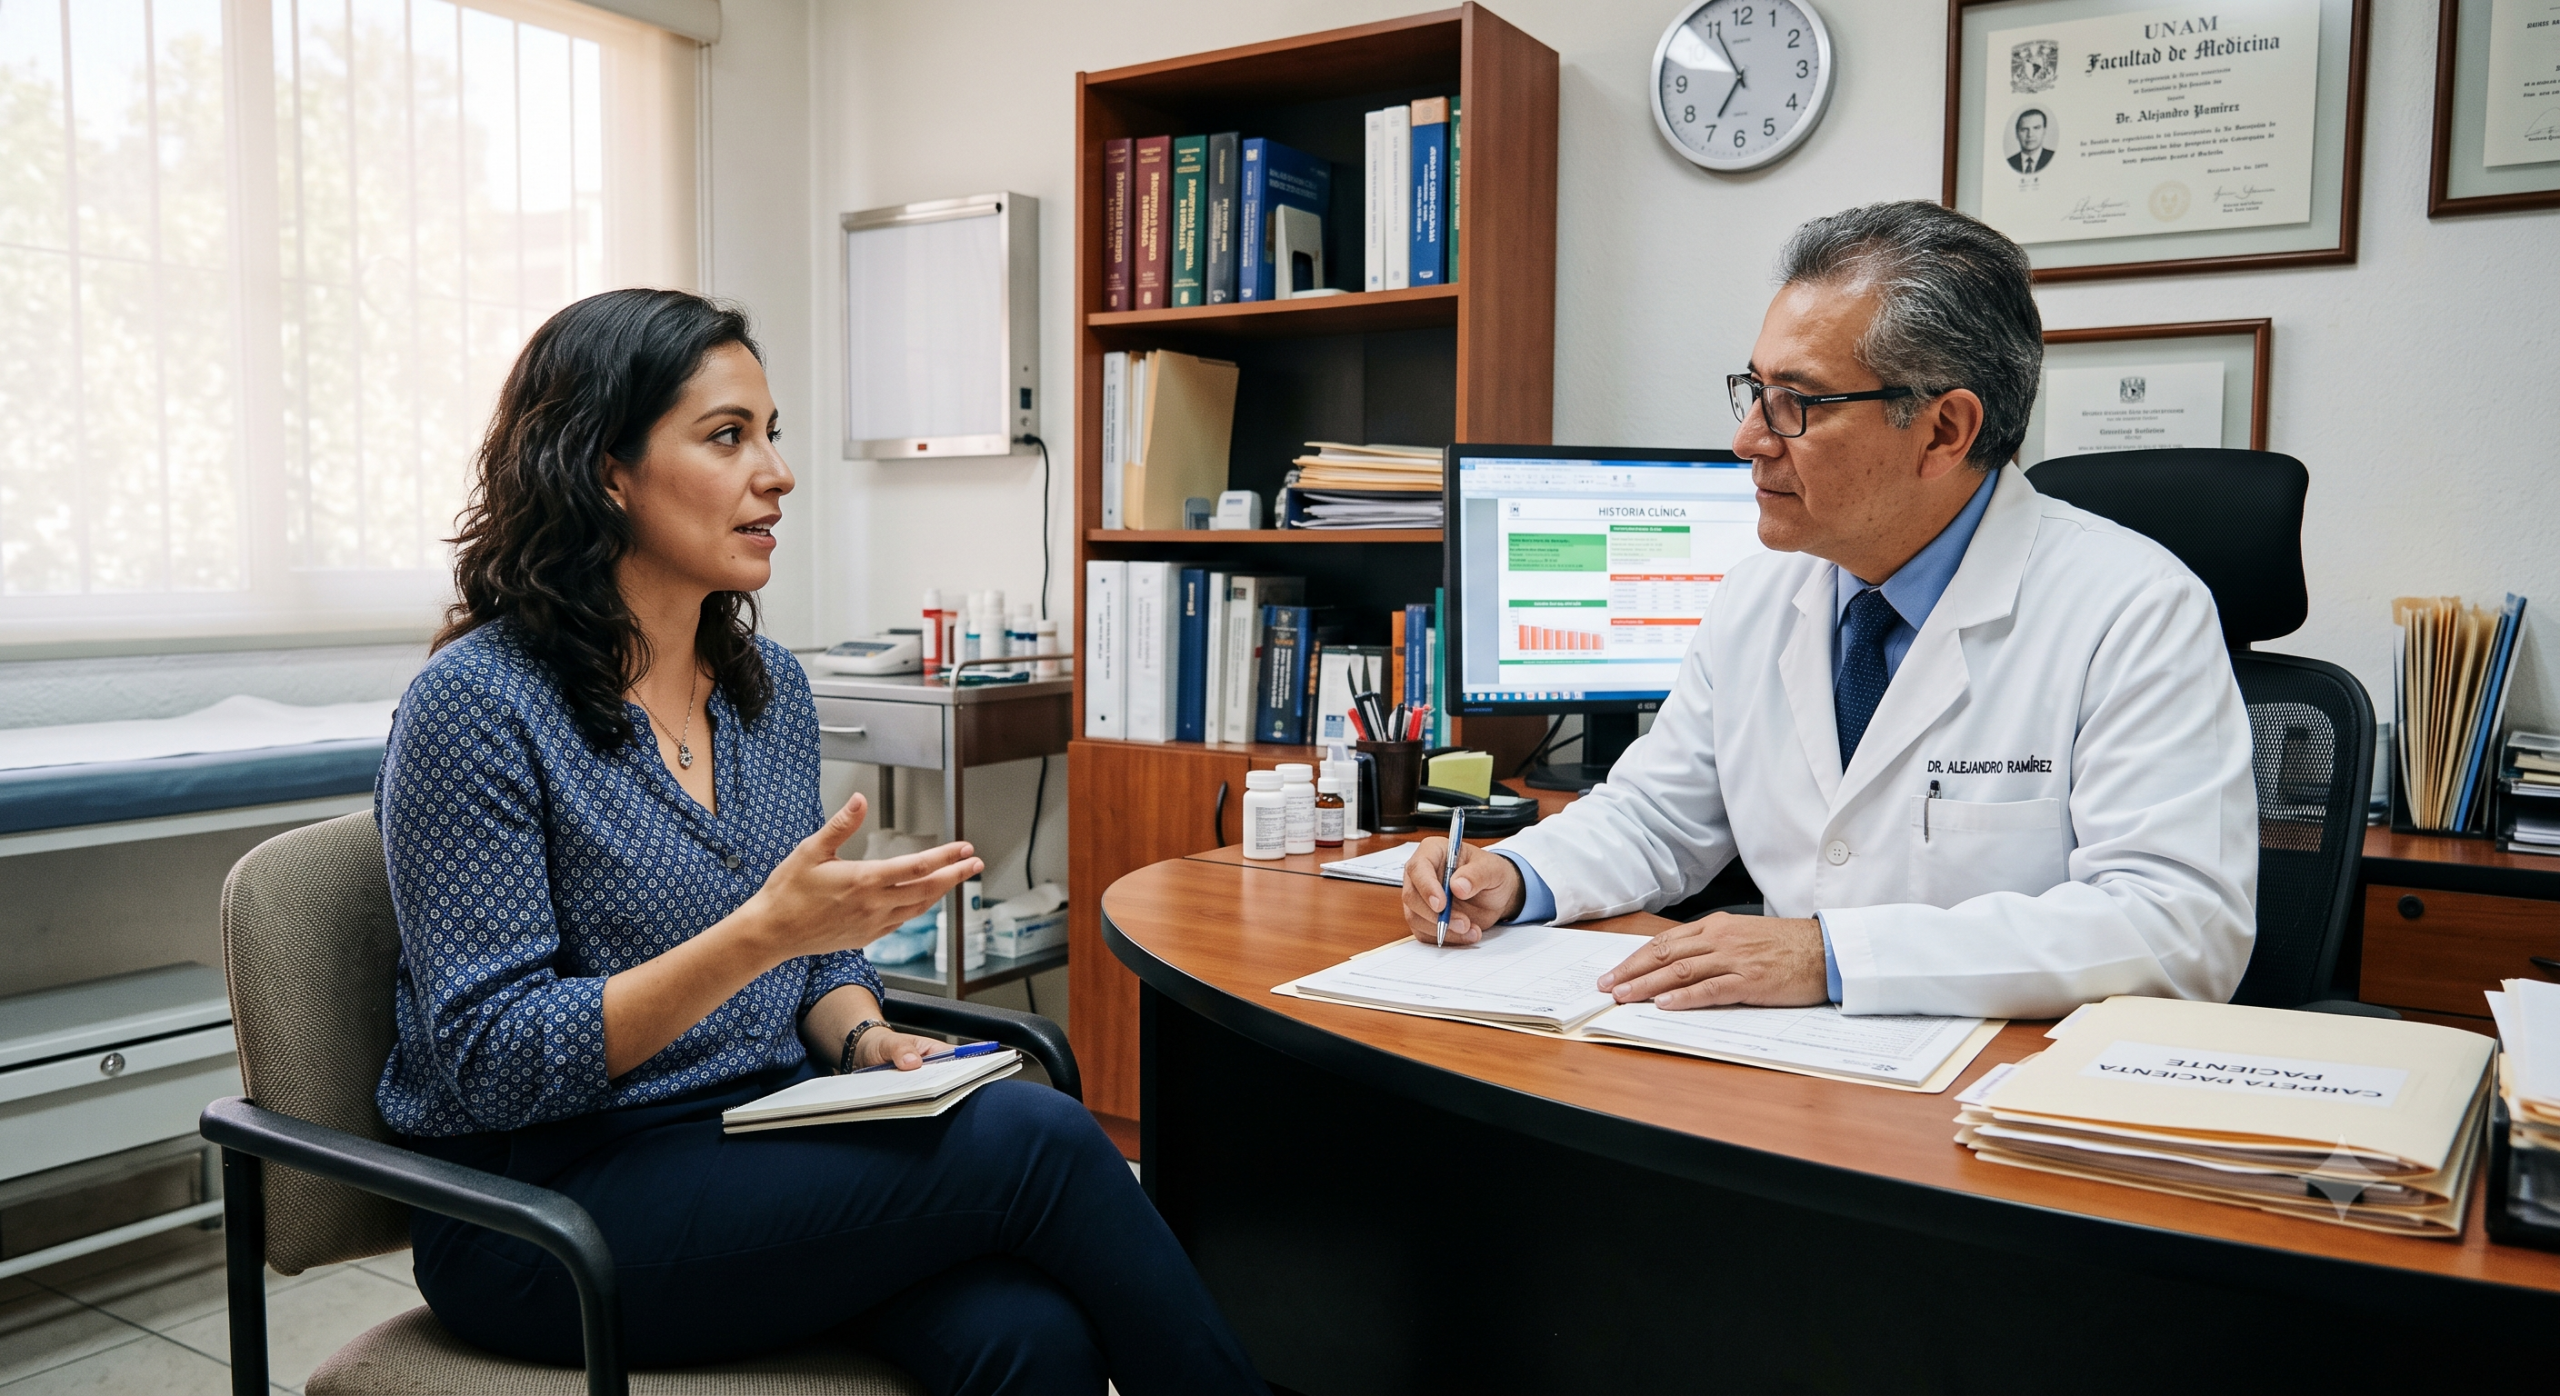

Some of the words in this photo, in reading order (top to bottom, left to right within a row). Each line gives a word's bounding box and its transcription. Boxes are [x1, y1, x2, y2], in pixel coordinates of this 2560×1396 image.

[1731, 6, 1754, 26] 12
[1768, 9, 1776, 27] 1
[1706, 20, 1722, 39] 11
[2144, 15, 2218, 40] UNAM
[1787, 29, 1800, 48] 2
[2085, 47, 2162, 75] Facultad
[2168, 45, 2187, 62] de
[2194, 34, 2280, 60] Medicina
[1796, 60, 1809, 78] 3
[1676, 76, 1687, 93] 9
[1786, 93, 1798, 111] 4
[1684, 105, 1695, 123] 8
[2137, 107, 2189, 123] Alejandro
[1705, 124, 1717, 142] 7
[1763, 118, 1775, 136] 5
[1734, 130, 1745, 148] 6
[1599, 507, 1645, 517] HISTORIA
[1648, 505, 1687, 518] CLÍNICA
[1927, 760, 1944, 774] DR.
[1947, 760, 2004, 774] ALEJANDRO
[2007, 754, 2052, 774] RAMÍREZ
[2099, 1064, 2234, 1084] PACIENTA
[2166, 1059, 2323, 1081] PACIENTE
[2244, 1080, 2383, 1098] CARPETA
